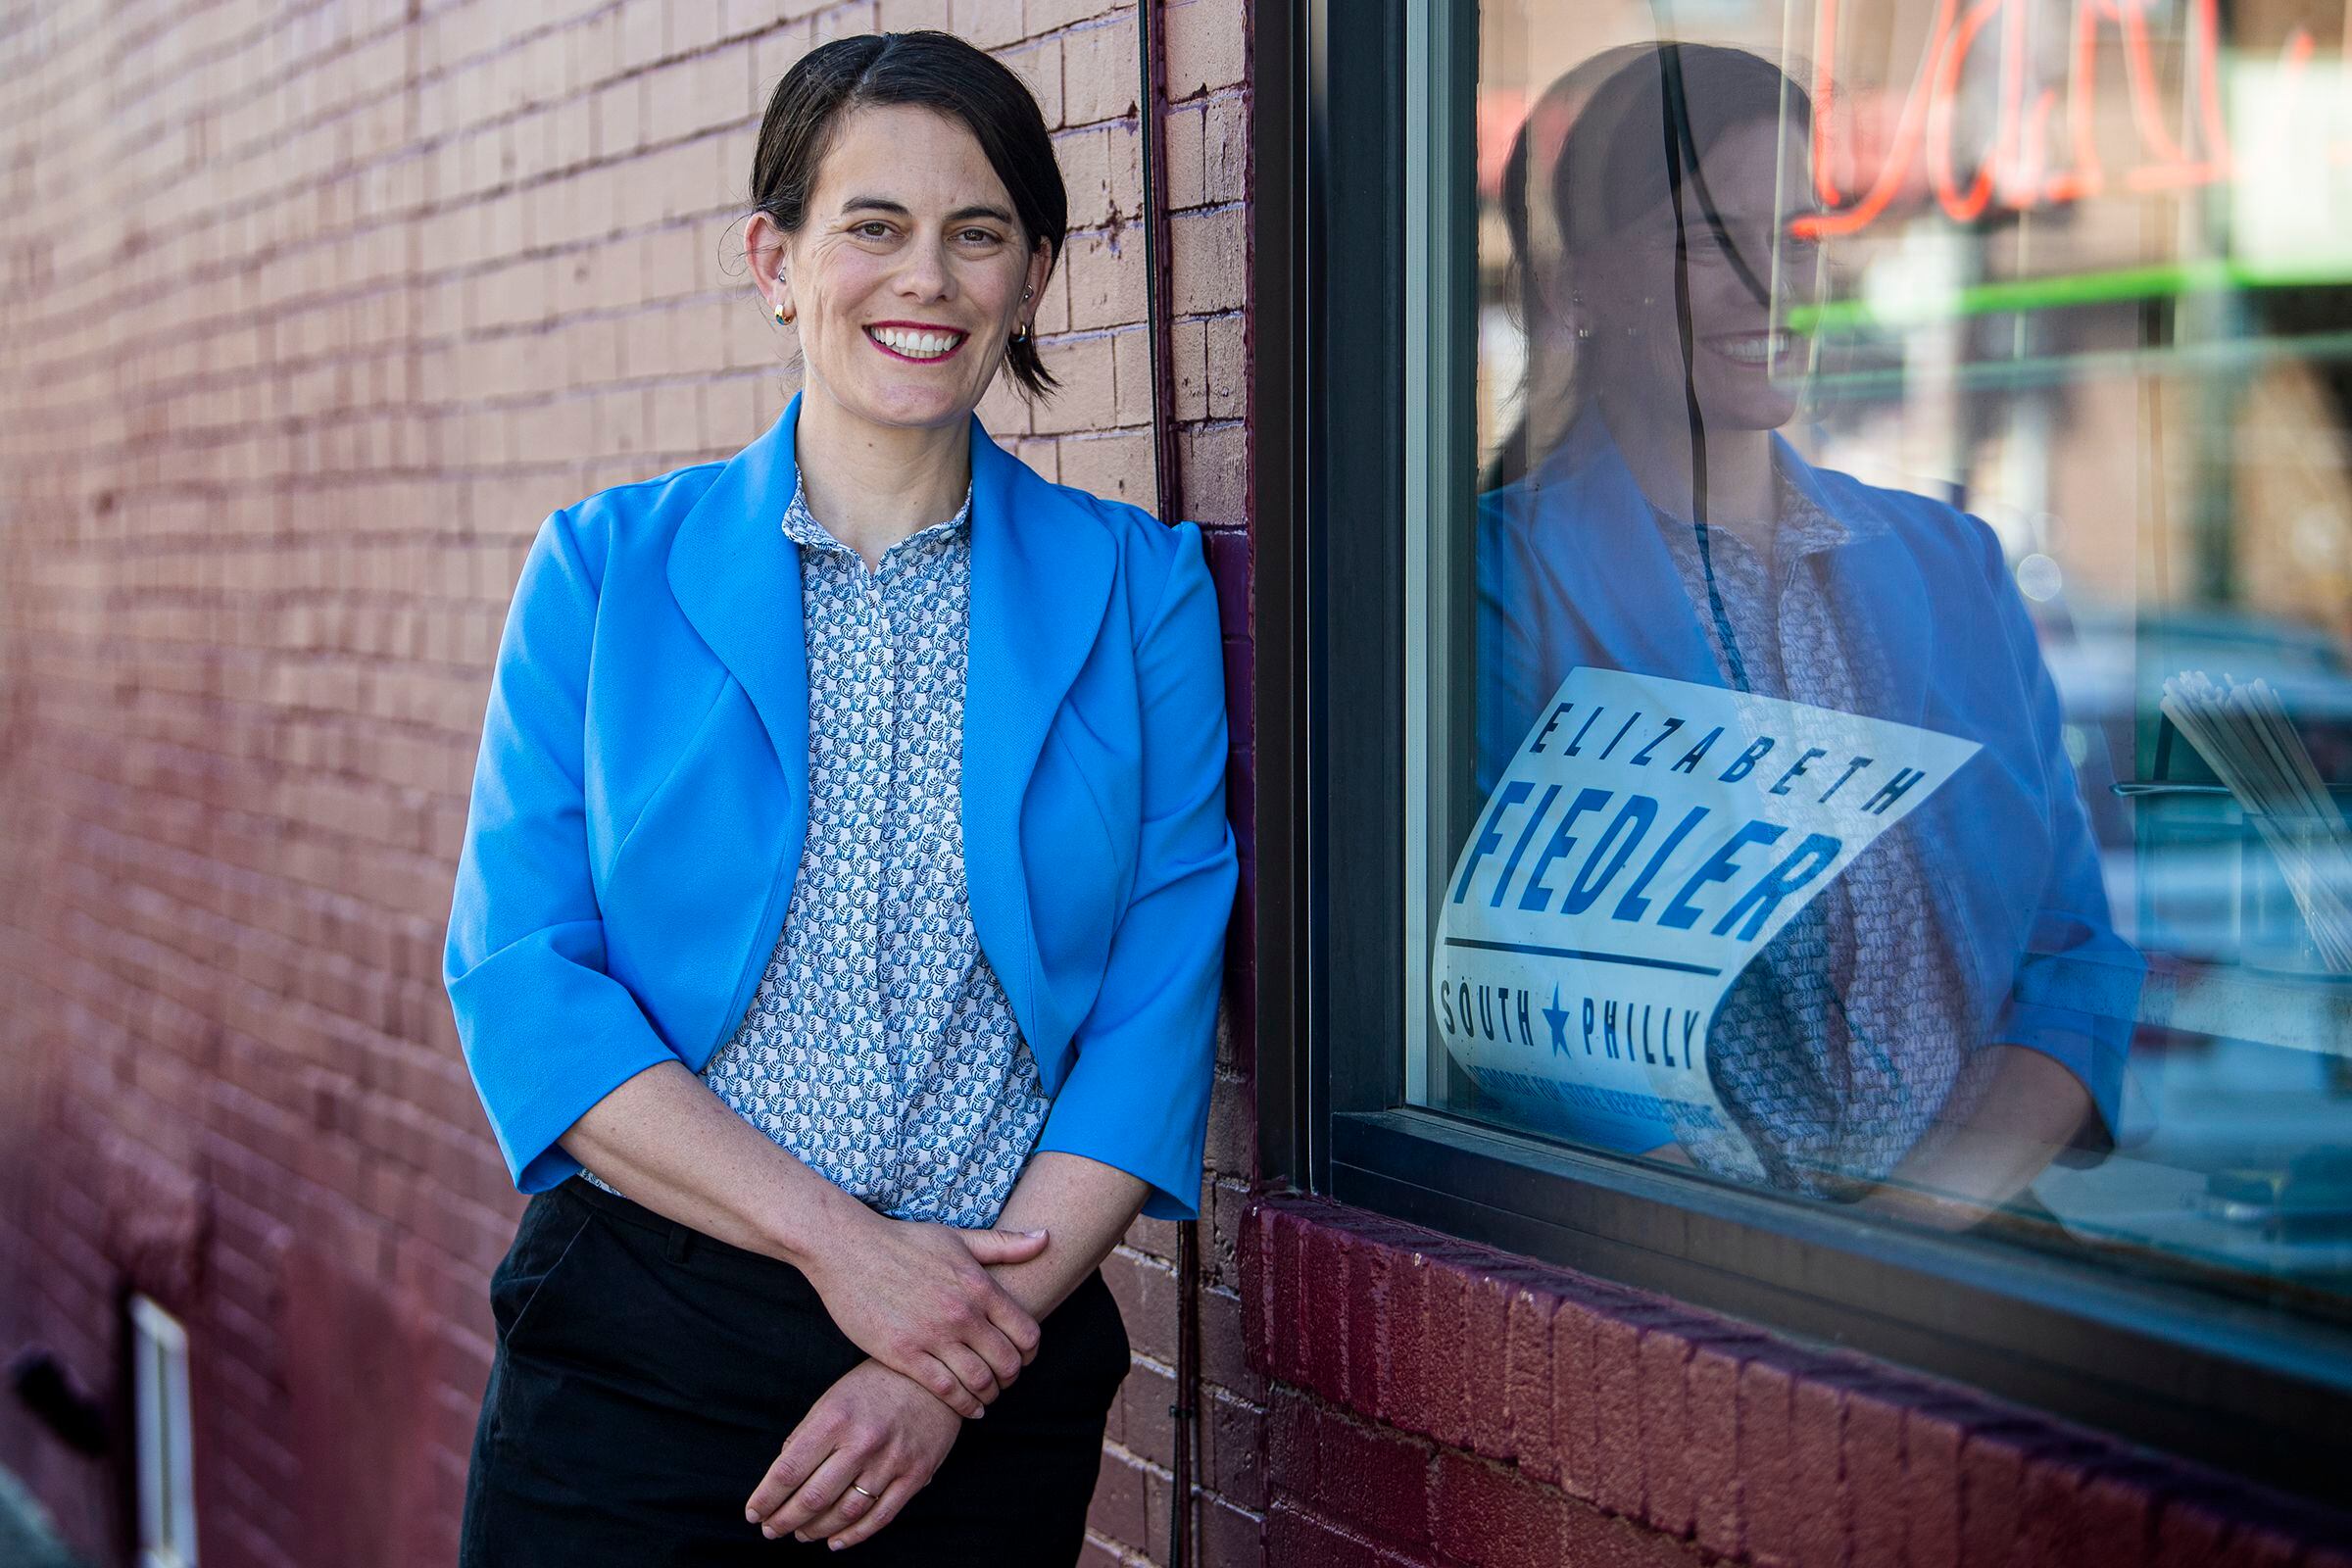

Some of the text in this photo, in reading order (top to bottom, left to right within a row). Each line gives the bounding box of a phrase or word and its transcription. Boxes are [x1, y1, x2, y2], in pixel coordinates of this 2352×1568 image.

[1529, 703, 1925, 814] ELIZABETH
[1453, 781, 1842, 942] FIEDLER
[1440, 980, 1700, 1070] SOUTH PHILLY
